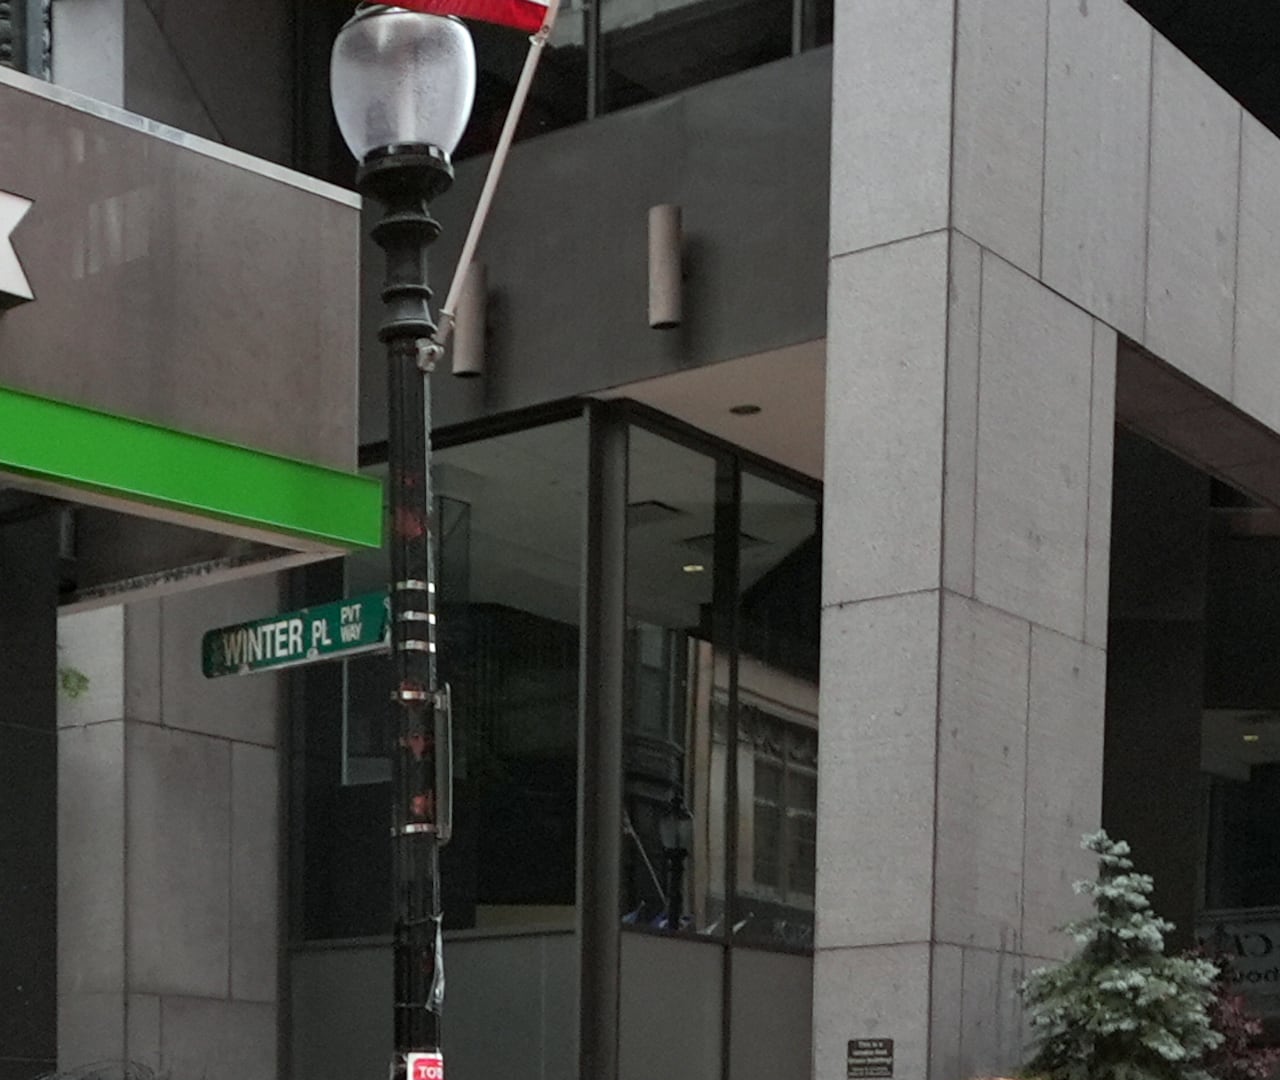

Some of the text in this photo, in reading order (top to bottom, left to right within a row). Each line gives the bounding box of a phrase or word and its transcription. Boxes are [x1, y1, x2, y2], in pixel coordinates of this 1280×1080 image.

[341, 603, 362, 625] PVT
[223, 618, 332, 667] WINTER PL
[341, 622, 362, 643] WAY
